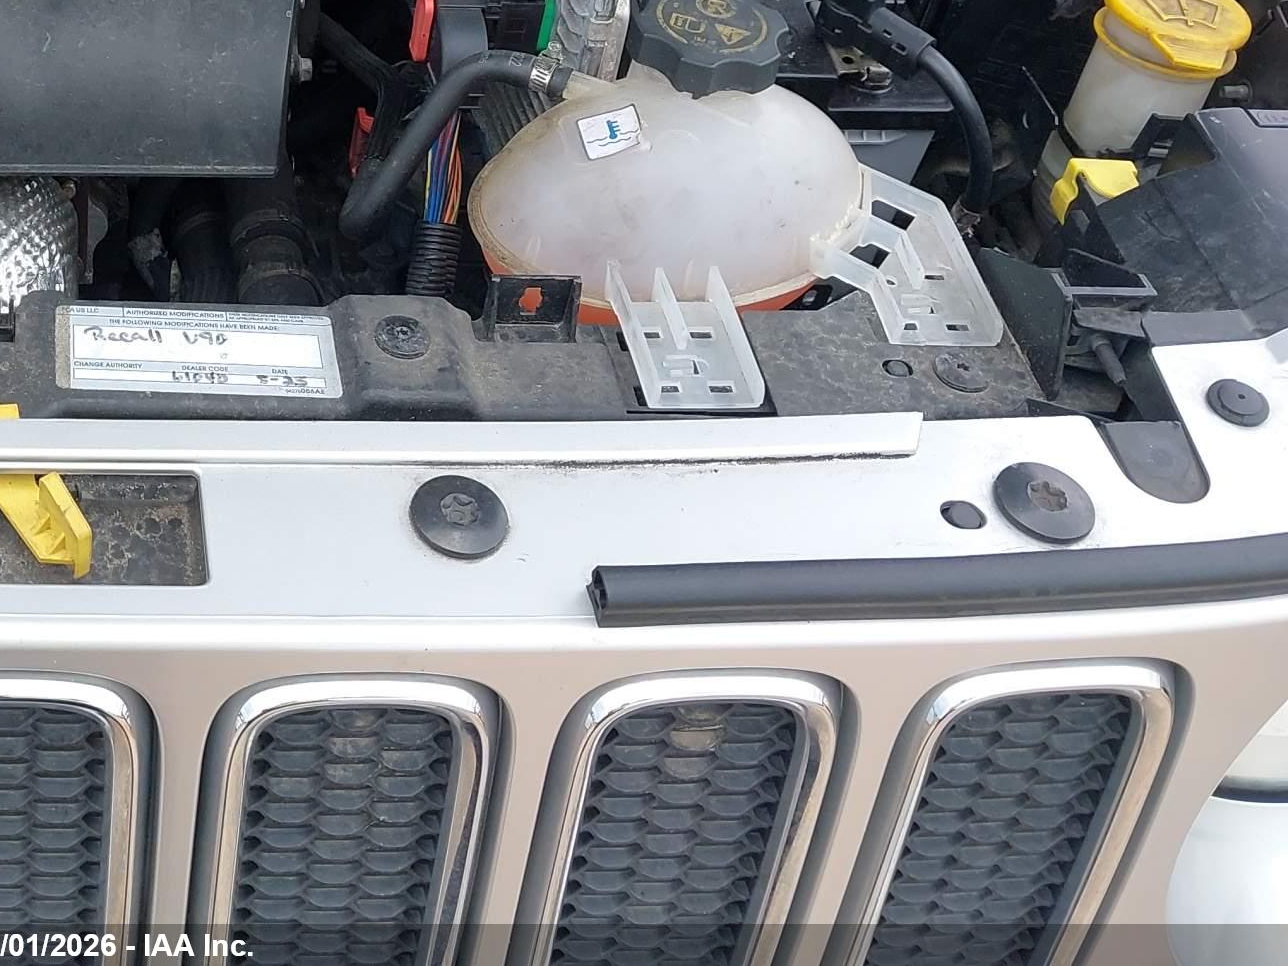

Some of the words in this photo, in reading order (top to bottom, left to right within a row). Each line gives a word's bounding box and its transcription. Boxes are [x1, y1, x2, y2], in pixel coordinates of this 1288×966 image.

[126, 309, 168, 317] AUTHORIZED
[169, 310, 224, 319] MODIFICATIONS
[84, 325, 163, 343] Recall
[74, 360, 104, 368] CHANGE
